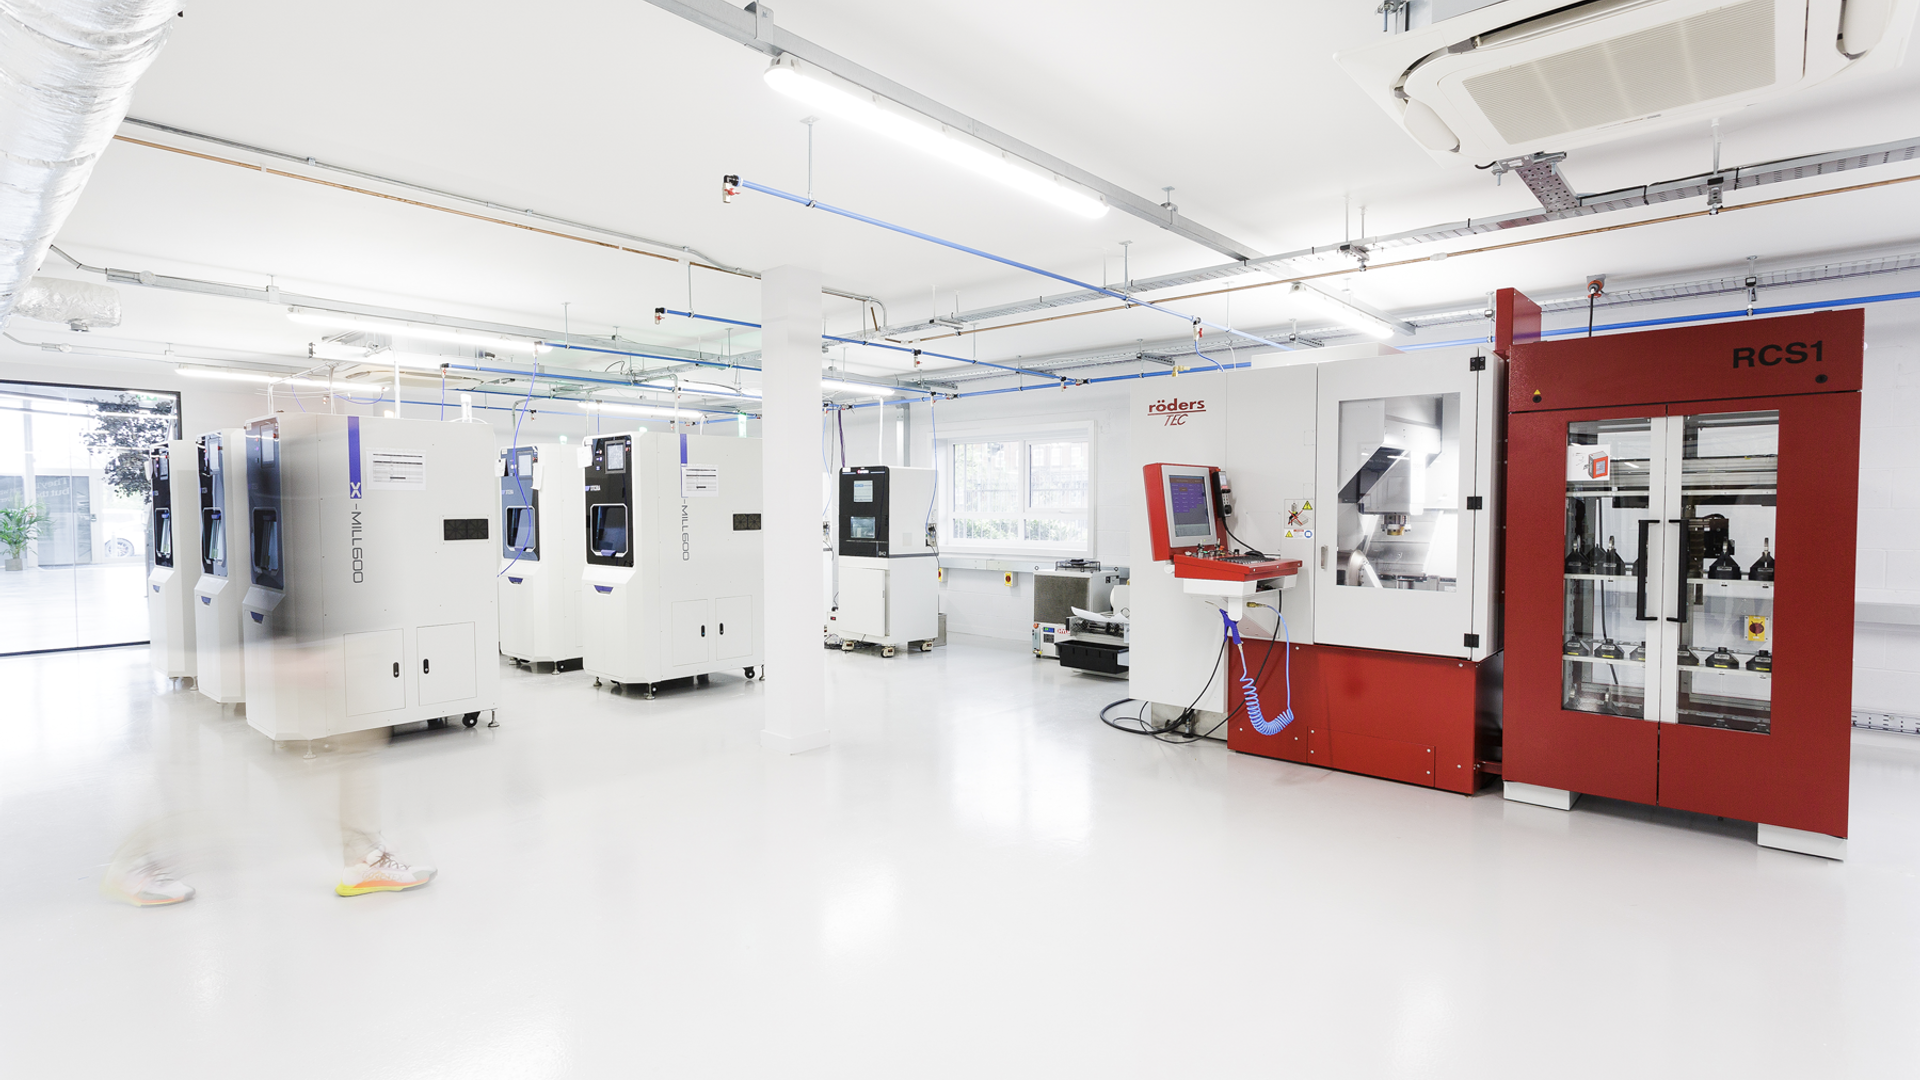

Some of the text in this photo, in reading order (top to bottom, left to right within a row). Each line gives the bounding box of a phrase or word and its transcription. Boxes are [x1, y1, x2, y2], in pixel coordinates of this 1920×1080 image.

[1733, 340, 1823, 369] RCS1
[1148, 398, 1206, 413] röders
[1164, 413, 1189, 426] TEC
[681, 498, 690, 561] -MILL600
